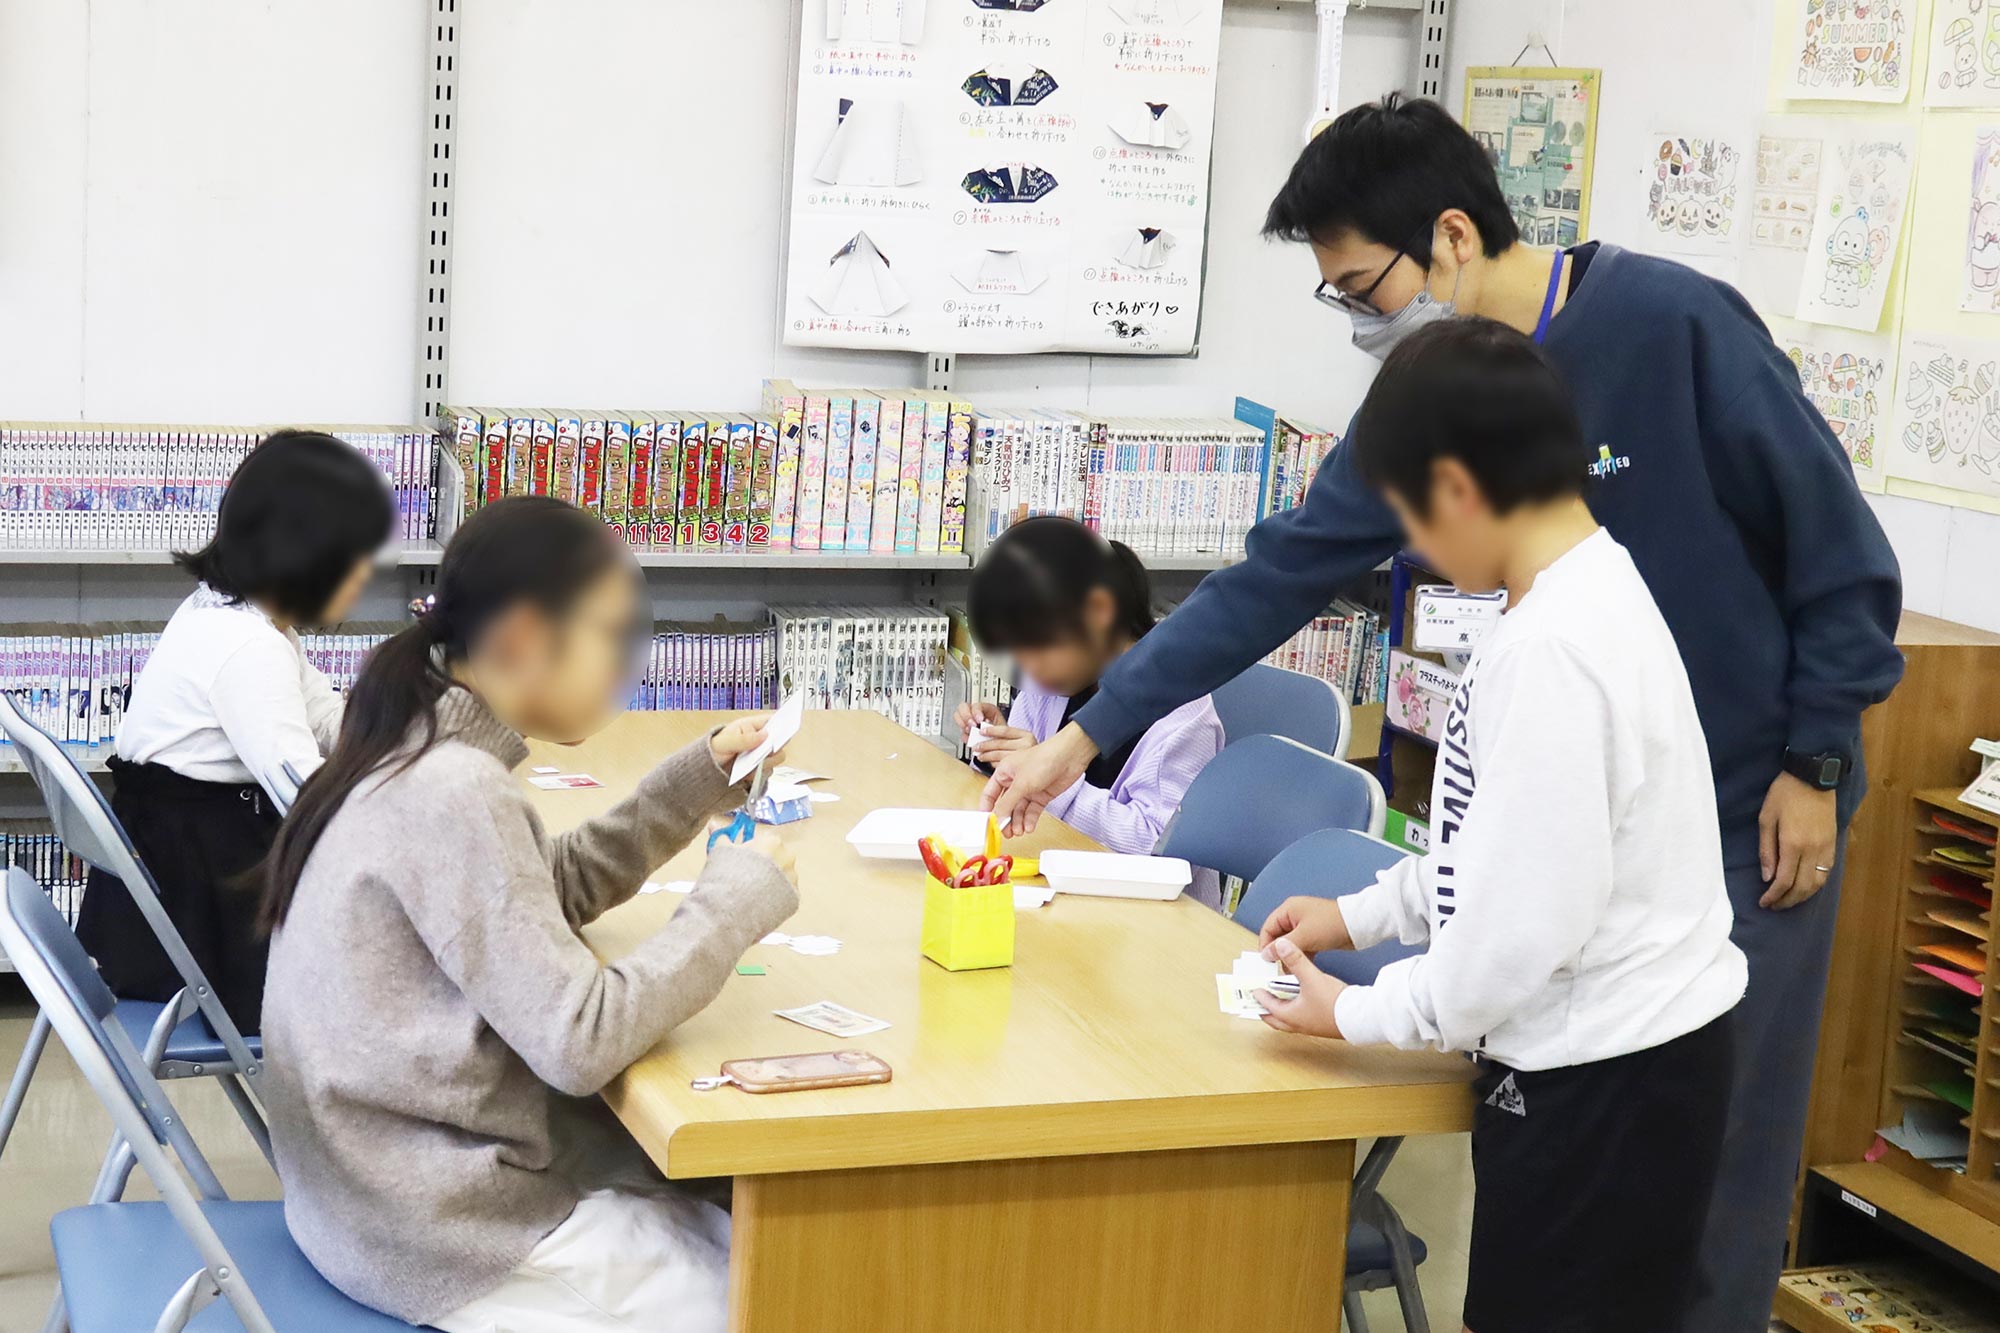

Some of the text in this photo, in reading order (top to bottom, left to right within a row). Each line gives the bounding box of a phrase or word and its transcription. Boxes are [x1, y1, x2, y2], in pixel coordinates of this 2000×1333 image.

[1821, 23, 1889, 43] SUMMER
[628, 523, 648, 544] 11
[654, 523, 675, 543] 12
[682, 523, 696, 544] 1
[702, 522, 721, 542] 3
[726, 523, 744, 543] 4
[750, 524, 769, 543] 2
